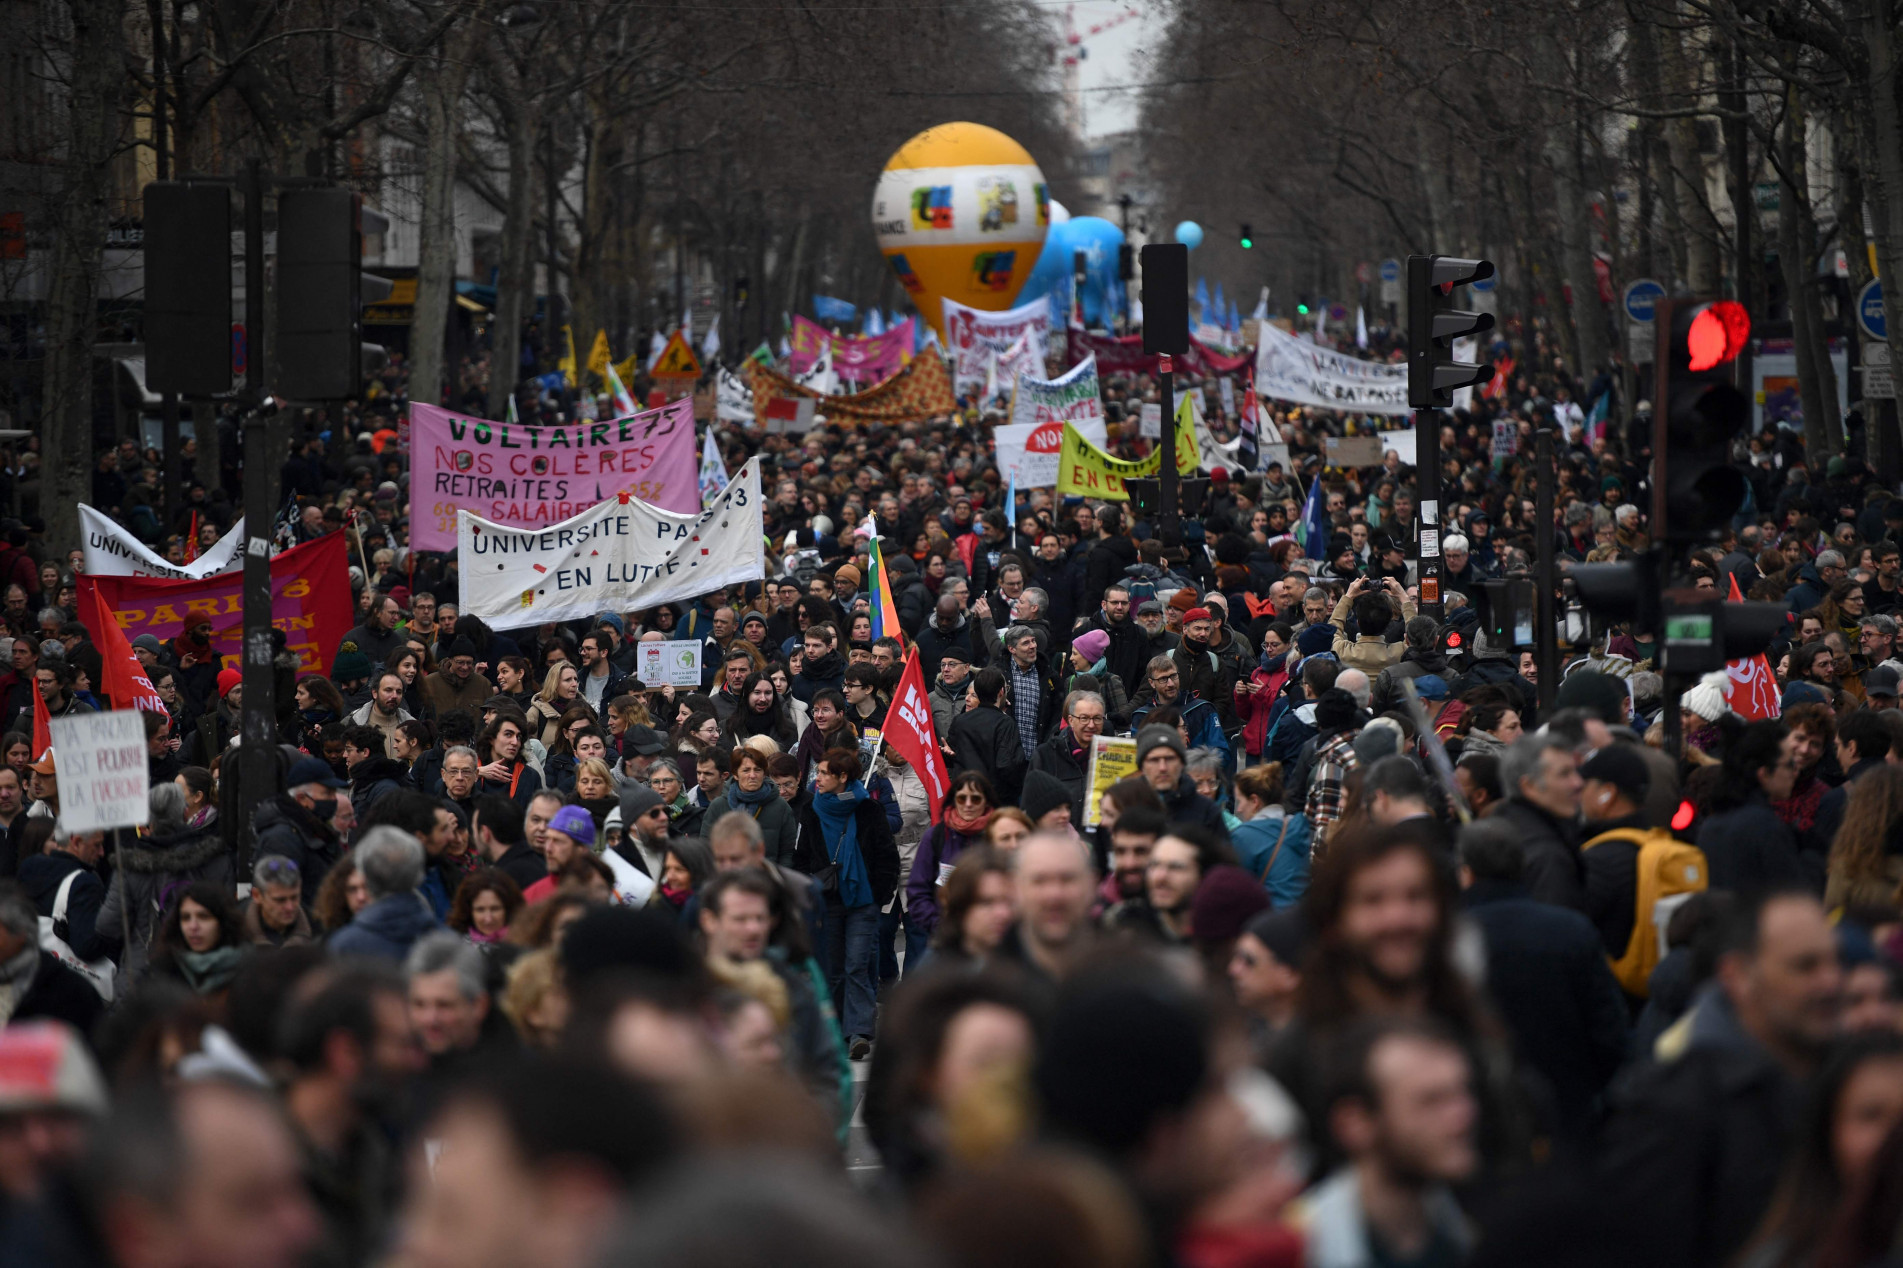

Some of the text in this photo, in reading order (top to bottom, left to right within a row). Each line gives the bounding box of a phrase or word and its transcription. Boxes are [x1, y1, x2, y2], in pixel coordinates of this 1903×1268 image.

[641, 407, 681, 440] 75
[435, 445, 655, 476] NOS COLÈRES
[1073, 465, 1099, 488] EN
[473, 516, 630, 555] UNIVERSITE
[557, 556, 680, 590] EN LUTTE
[113, 578, 311, 629] PARI 8
